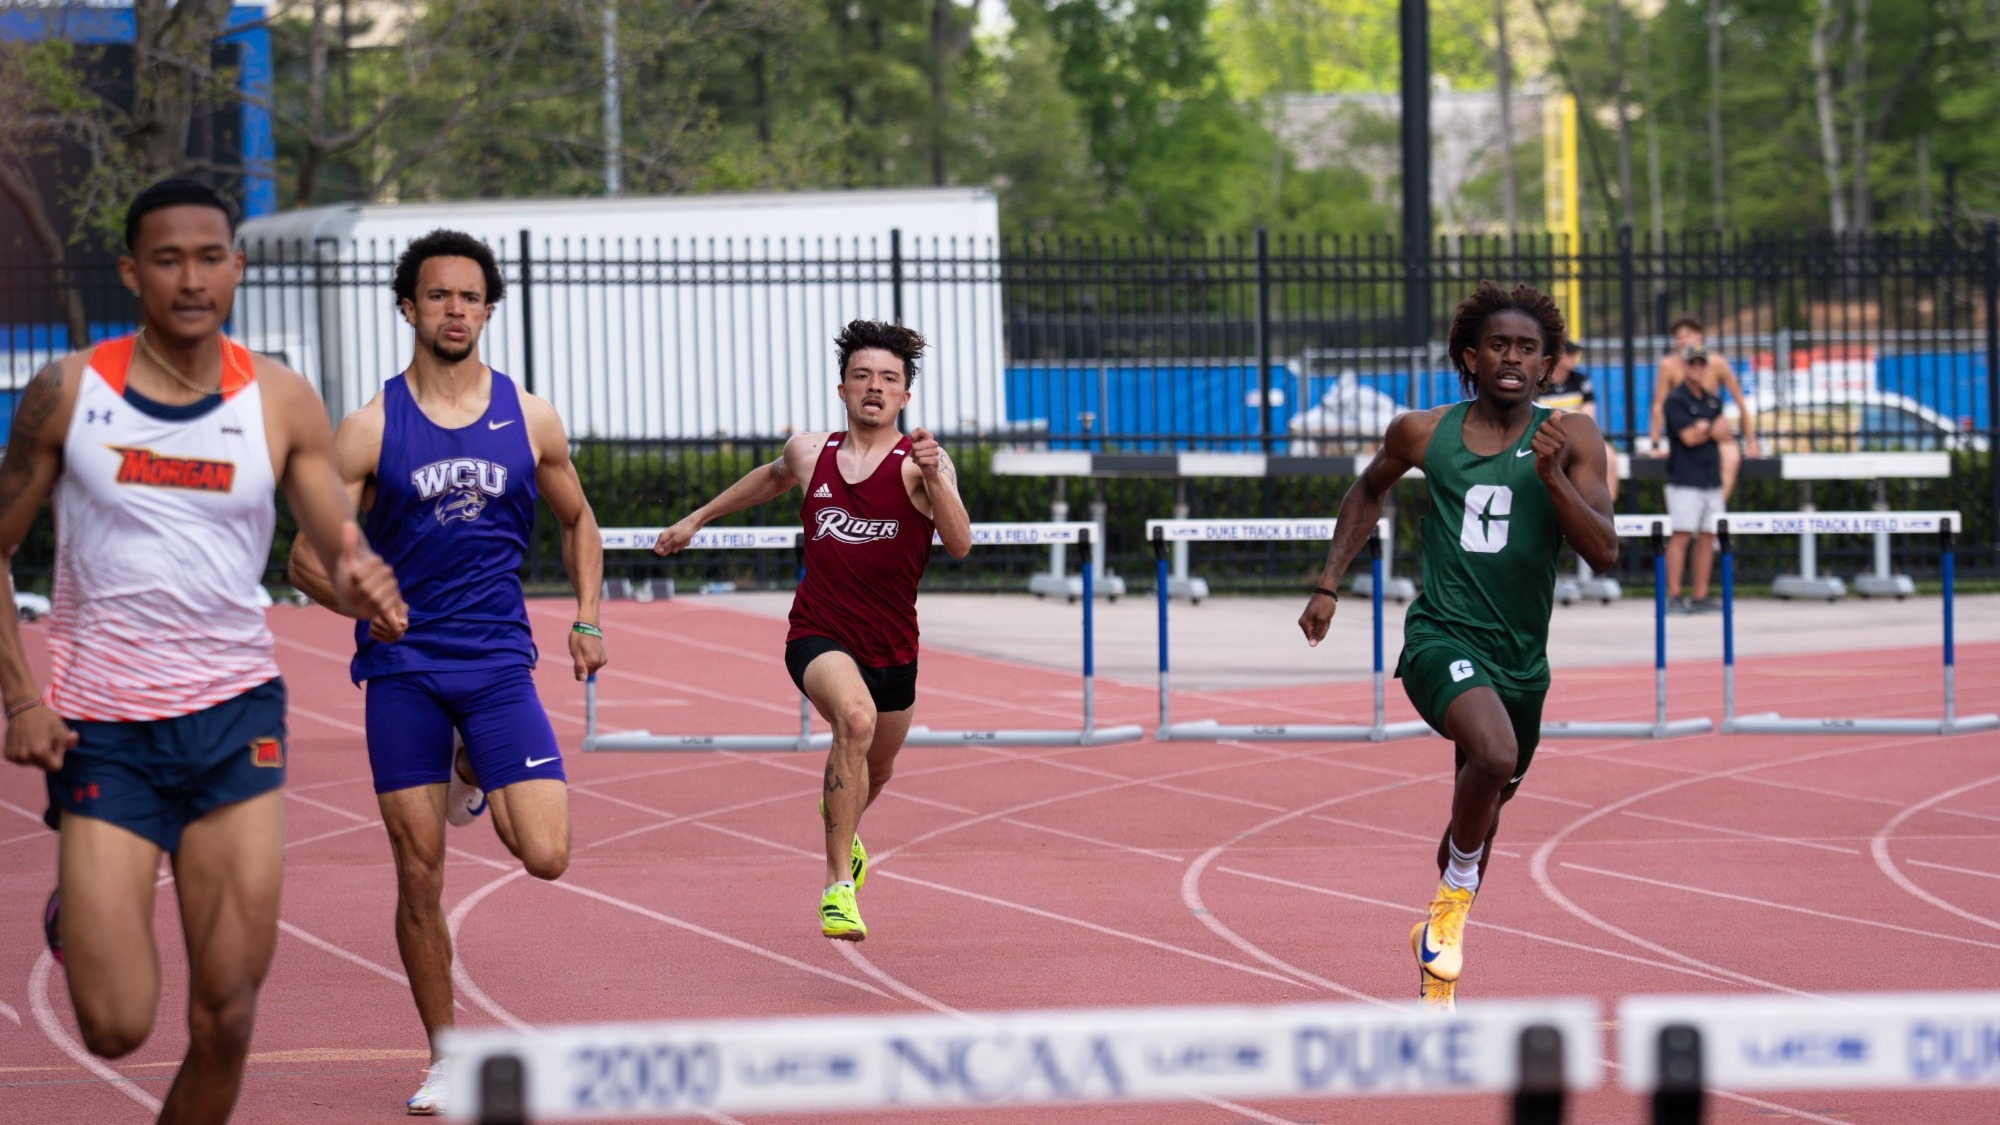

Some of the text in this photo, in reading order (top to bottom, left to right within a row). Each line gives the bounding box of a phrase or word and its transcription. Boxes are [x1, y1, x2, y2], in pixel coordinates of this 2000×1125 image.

[116, 446, 234, 492] MORGAN
[412, 458, 507, 500] WCU
[812, 506, 899, 544] RIDER
[995, 530, 1002, 543] &
[1005, 529, 1038, 543] FIELD
[1206, 526, 1237, 539] DUKE
[1242, 525, 1280, 539] TRACK
[1284, 525, 1292, 539] &
[1296, 525, 1329, 538] FIELD
[1772, 519, 1804, 532] DUKE
[1809, 519, 1849, 532] TRACK
[1854, 518, 1861, 532] &
[1864, 518, 1898, 532] FIELD
[712, 533, 719, 547] &
[723, 533, 756, 547] FIELD
[573, 1042, 721, 1105] 2000
[882, 1034, 1128, 1101] NCAA
[1294, 1020, 1481, 1088] DUKE
